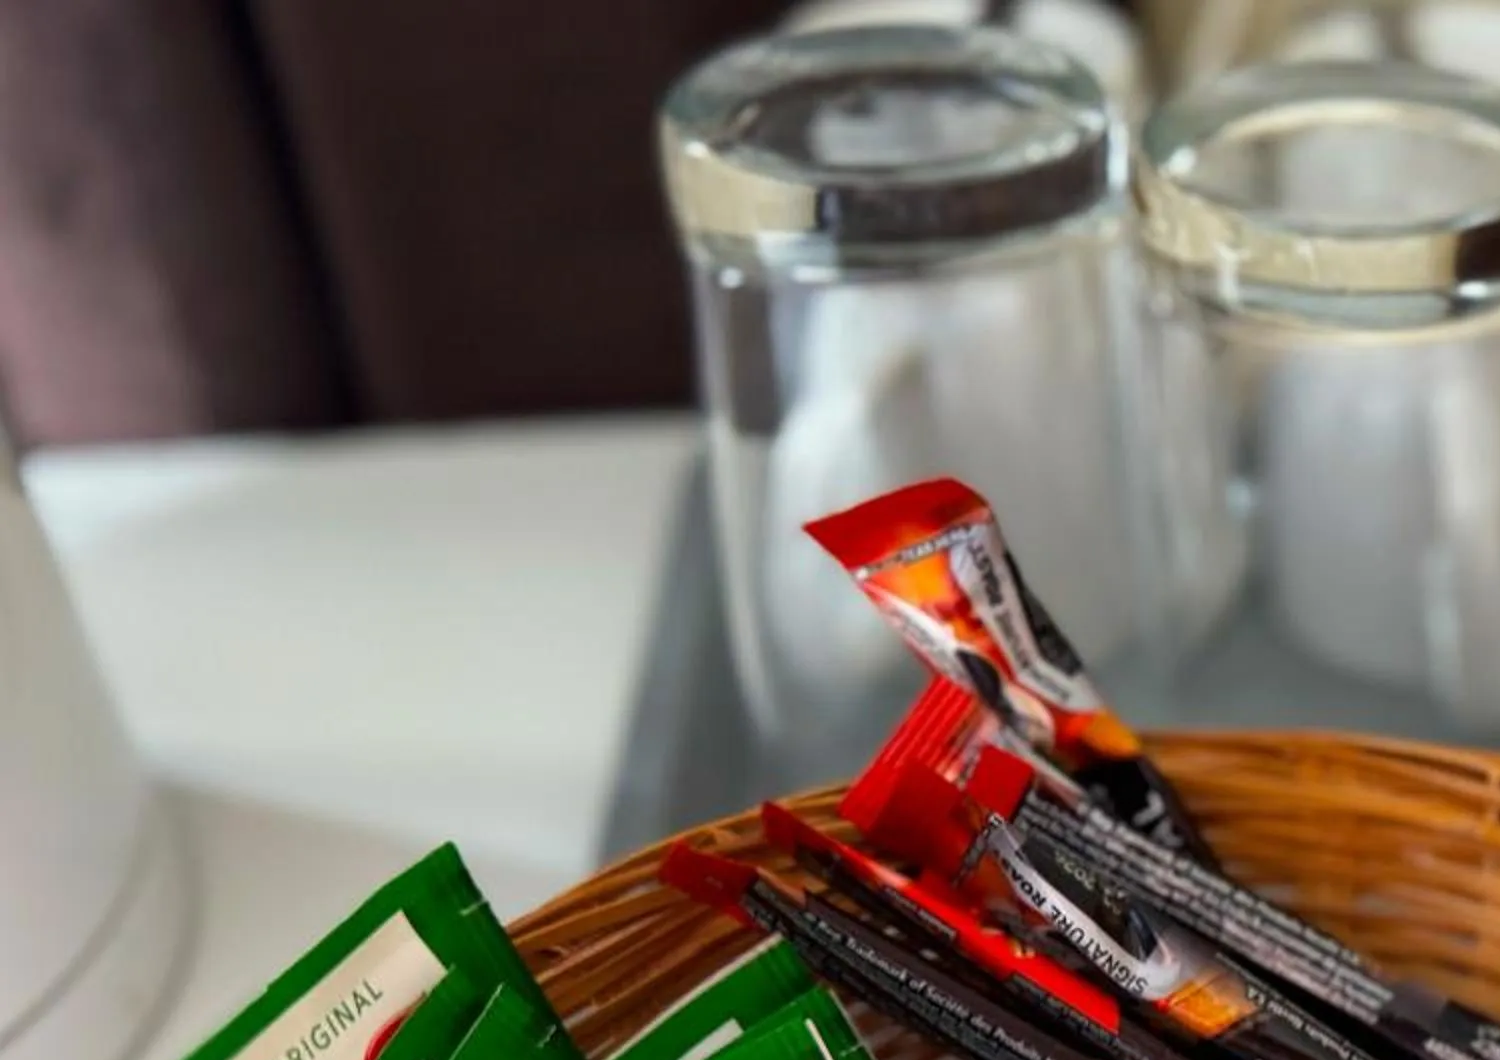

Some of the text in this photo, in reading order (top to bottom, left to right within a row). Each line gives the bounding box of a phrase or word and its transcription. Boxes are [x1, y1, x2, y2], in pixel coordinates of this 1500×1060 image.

[843, 936, 908, 982] Trademark
[907, 974, 927, 993] of
[968, 1013, 993, 1034] des
[1048, 903, 1147, 995] SIGNATURE
